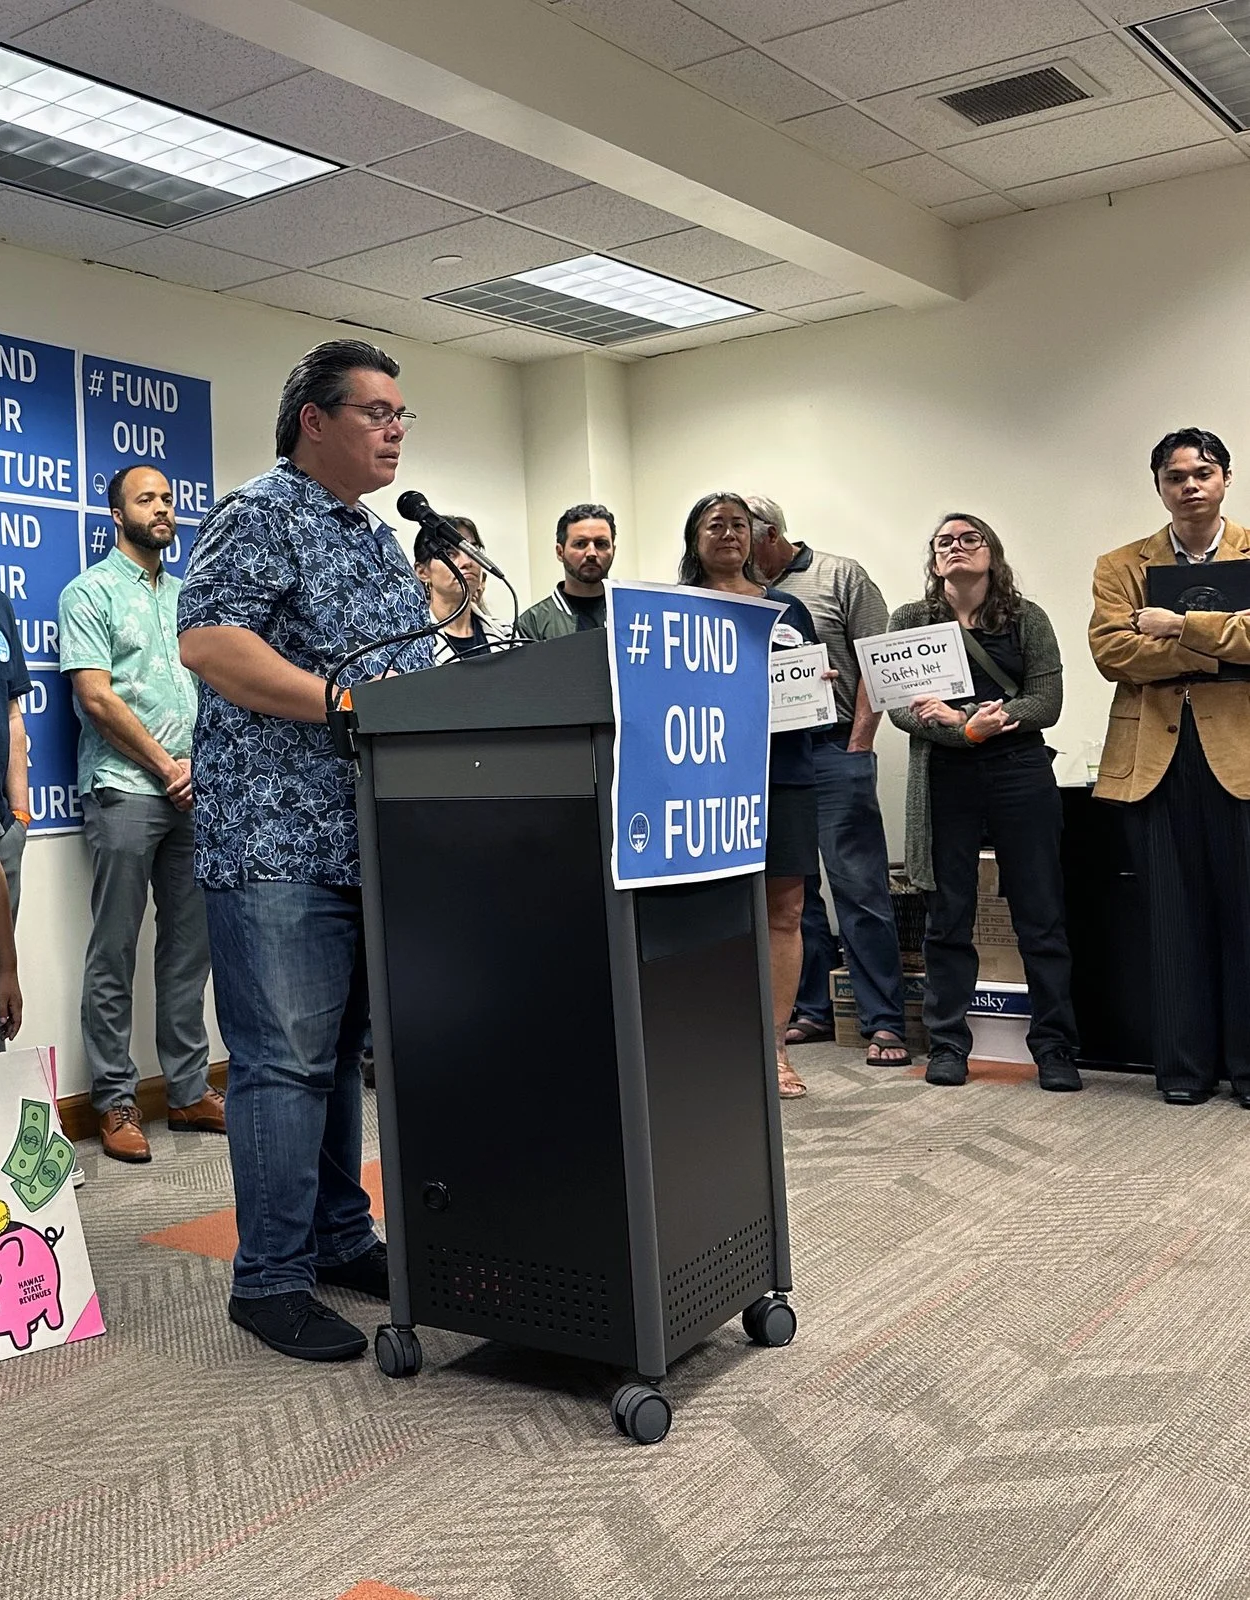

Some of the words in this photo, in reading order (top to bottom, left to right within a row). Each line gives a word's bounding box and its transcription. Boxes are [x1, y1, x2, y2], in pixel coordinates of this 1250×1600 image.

[88, 369, 104, 397] #
[112, 371, 179, 413] FUND
[113, 422, 166, 459] OUR
[171, 478, 208, 513] URE
[626, 613, 652, 665] #
[662, 611, 737, 674] FUND
[871, 647, 912, 665] Fund
[917, 643, 947, 656] Our
[790, 667, 816, 680] Our
[881, 666, 919, 684] Safety
[921, 662, 941, 676] Net
[18, 681, 47, 714] ND
[664, 704, 727, 765] OUR
[29, 785, 84, 820] URE
[664, 794, 762, 860] FUTURE
[971, 993, 1007, 1012] usky
[18, 1274, 45, 1289] HAWAII
[19, 1288, 51, 1305] REVENUES
[22, 1284, 43, 1295] STATE
